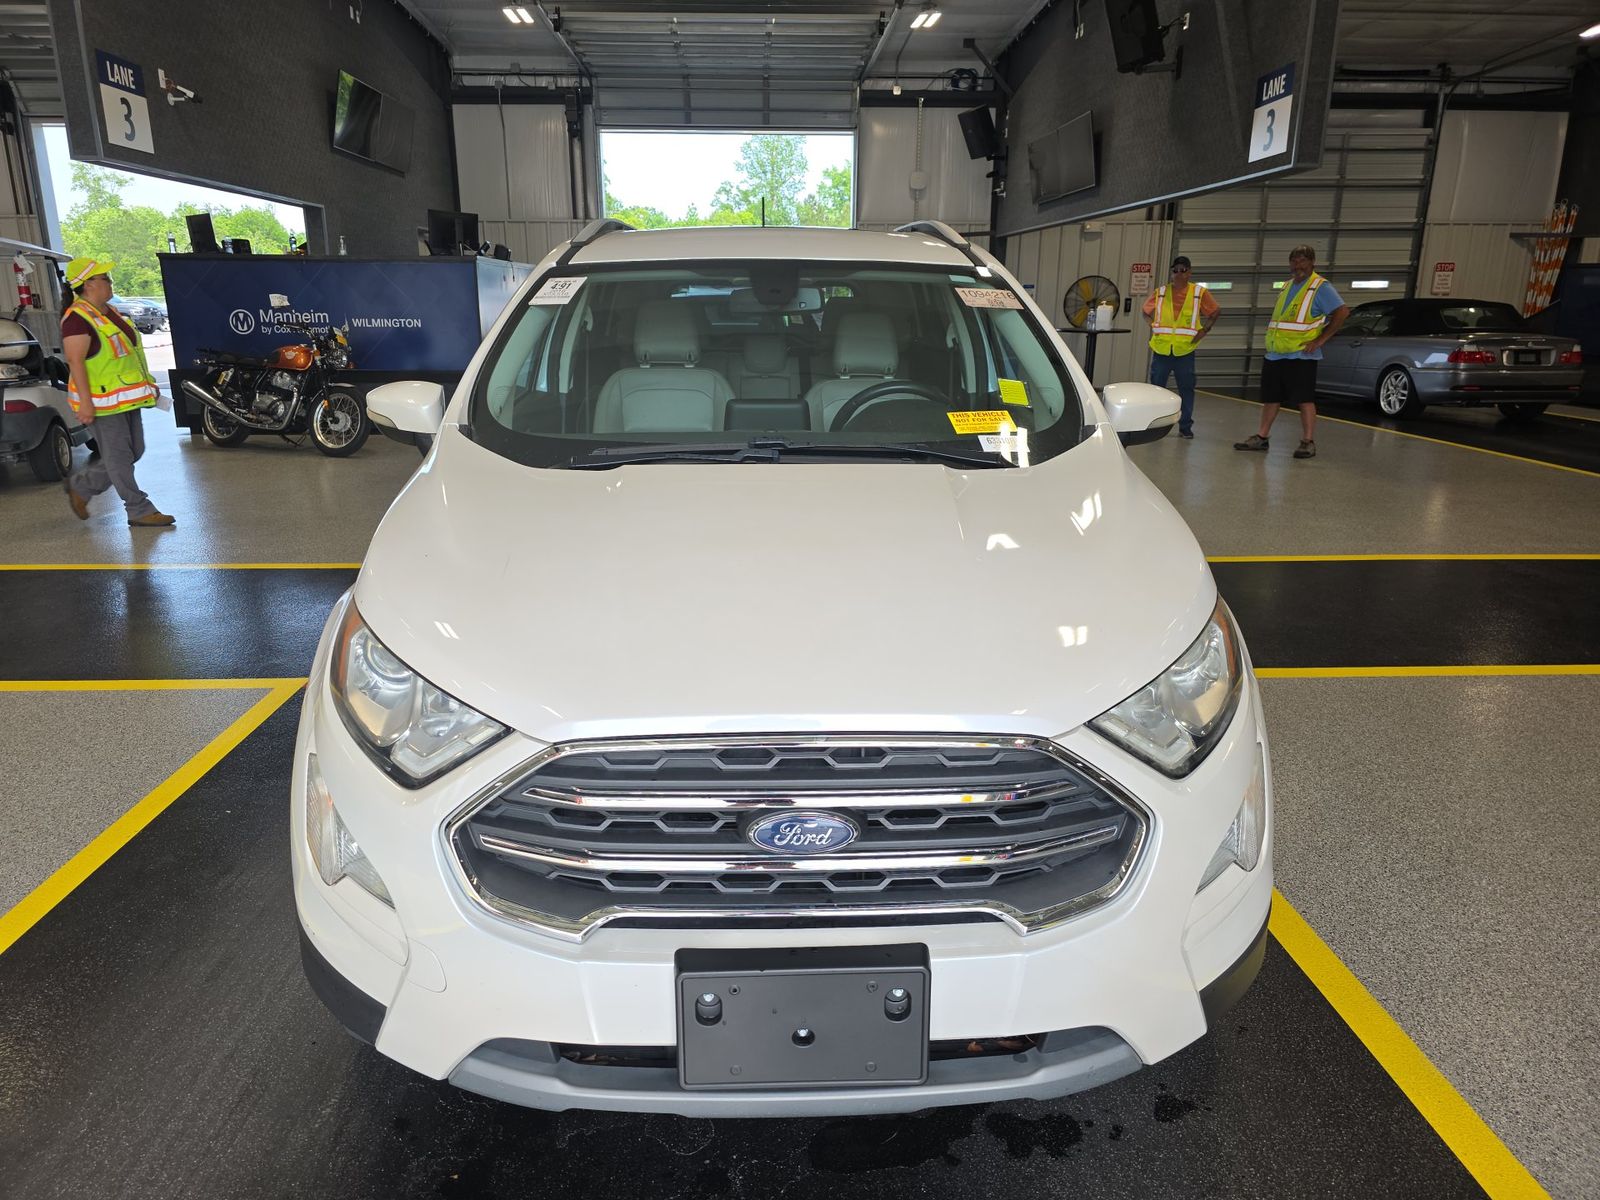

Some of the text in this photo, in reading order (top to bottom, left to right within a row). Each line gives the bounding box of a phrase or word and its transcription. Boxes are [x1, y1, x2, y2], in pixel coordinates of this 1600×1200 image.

[106, 60, 136, 90] LANE
[1262, 73, 1287, 101] LANE
[120, 97, 136, 142] 3
[1263, 108, 1276, 152] 3
[1132, 264, 1151, 272] STOP
[1436, 263, 1455, 271] STOP
[259, 309, 329, 323] Manheim
[351, 318, 422, 328] WILMINGTON
[261, 325, 272, 335] by
[274, 324, 292, 334] Cox
[774, 821, 833, 846] Ford
